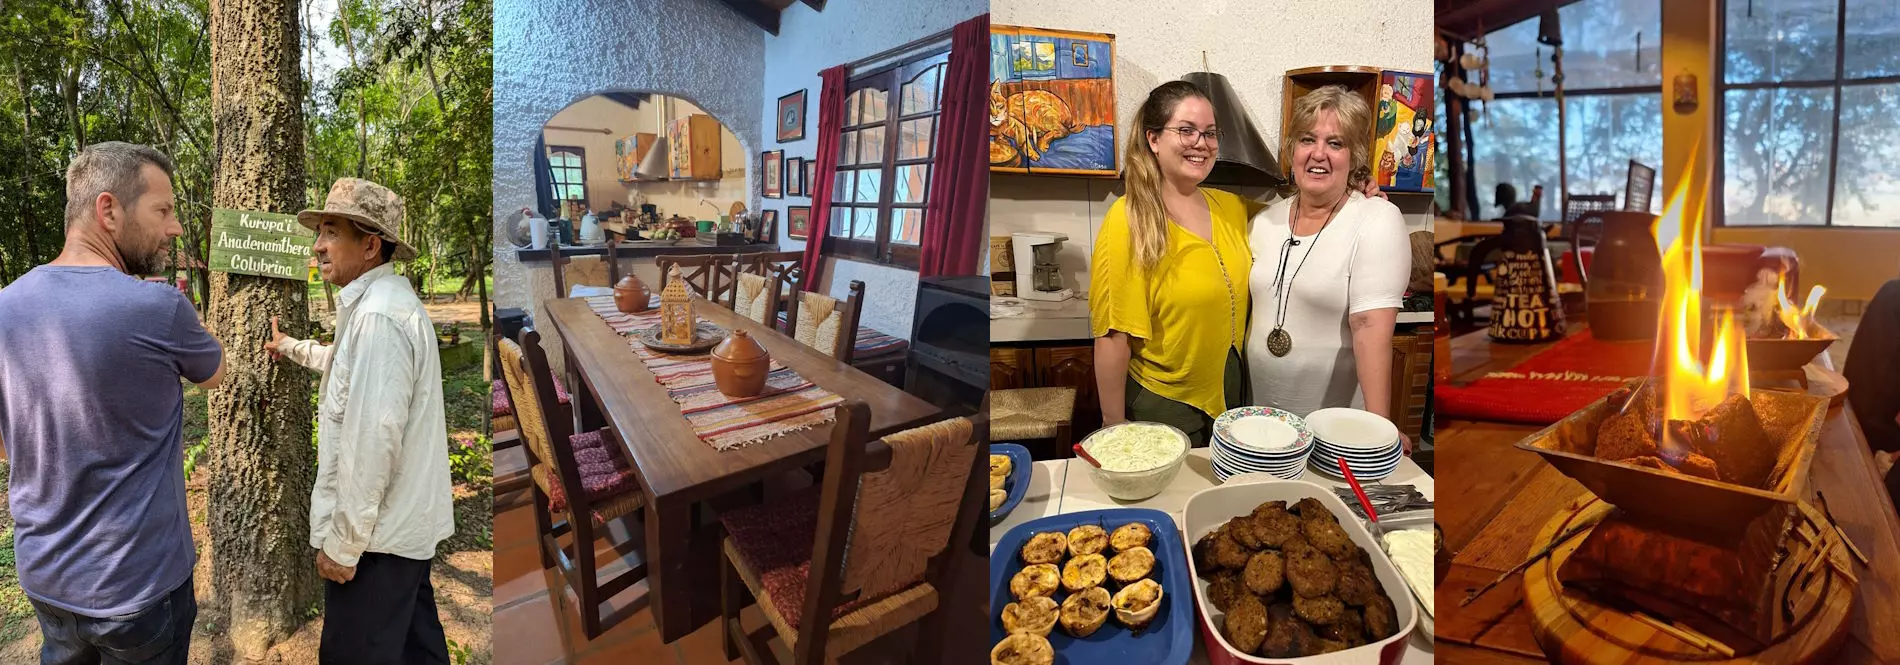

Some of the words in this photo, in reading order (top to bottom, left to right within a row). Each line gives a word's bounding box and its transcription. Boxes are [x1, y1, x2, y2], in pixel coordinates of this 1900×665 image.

[240, 213, 292, 232] Kurupa'i
[217, 231, 310, 256] Anadenamthera
[230, 254, 292, 276] Colubrina
[1507, 294, 1544, 308] TEA
[1503, 308, 1549, 328] HOT
